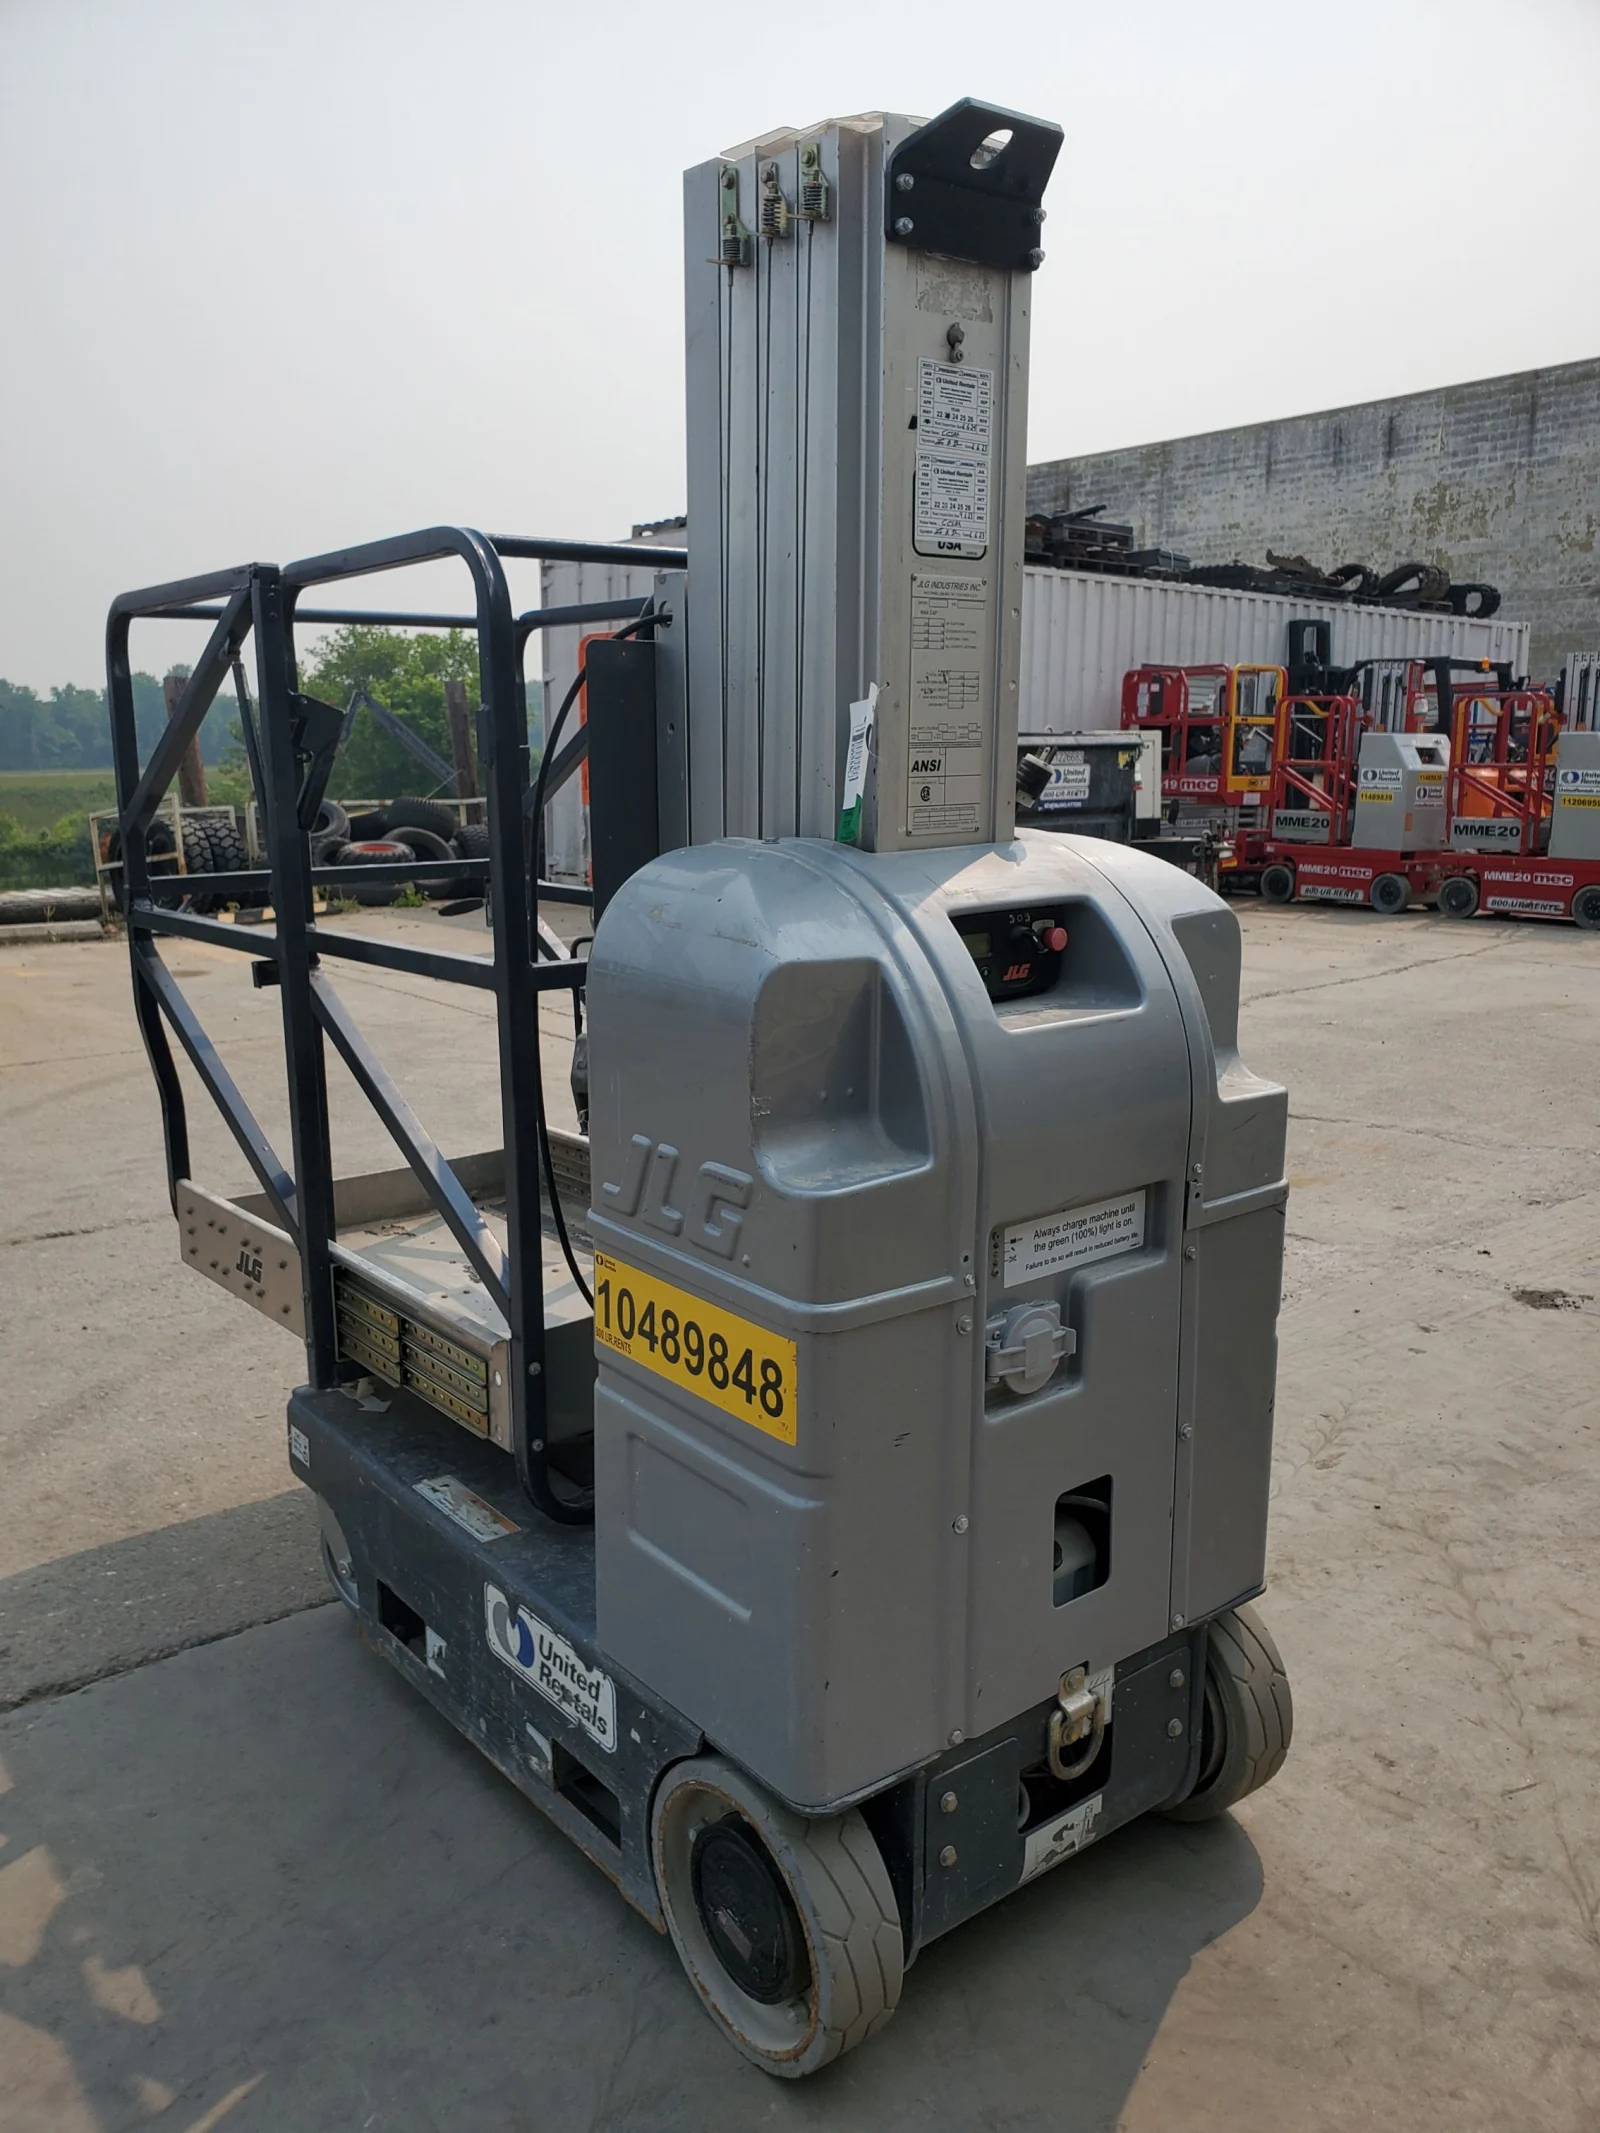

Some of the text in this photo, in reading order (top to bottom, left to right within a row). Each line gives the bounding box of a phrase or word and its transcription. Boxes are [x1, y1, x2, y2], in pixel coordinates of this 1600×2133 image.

[943, 378, 975, 389] United Rentals
[938, 542, 961, 551] USA
[917, 580, 930, 588] JLG
[930, 582, 969, 590] INDUSTRIES
[911, 759, 942, 772] ANSI
[1064, 768, 1086, 776] United
[1063, 776, 1086, 784] Rentals
[1182, 780, 1217, 790] mec
[1276, 816, 1330, 828] MME20
[1454, 824, 1520, 837] MME20
[1299, 864, 1371, 878] MME20 mec
[1484, 870, 1572, 884] MME20 mec
[1003, 963, 1030, 982] JLG
[602, 1133, 753, 1260] JLG
[1034, 1202, 1136, 1240] Always charge machine until
[1034, 1217, 1134, 1252] the green (100%) light is on.
[1026, 1260, 1042, 1271] Failure
[1074, 1246, 1088, 1256] result
[1094, 1239, 1114, 1250] reduced
[1114, 1234, 1130, 1245] battery
[236, 1250, 262, 1284] JLG
[598, 1278, 784, 1418] 10489848
[538, 1634, 600, 1702] United
